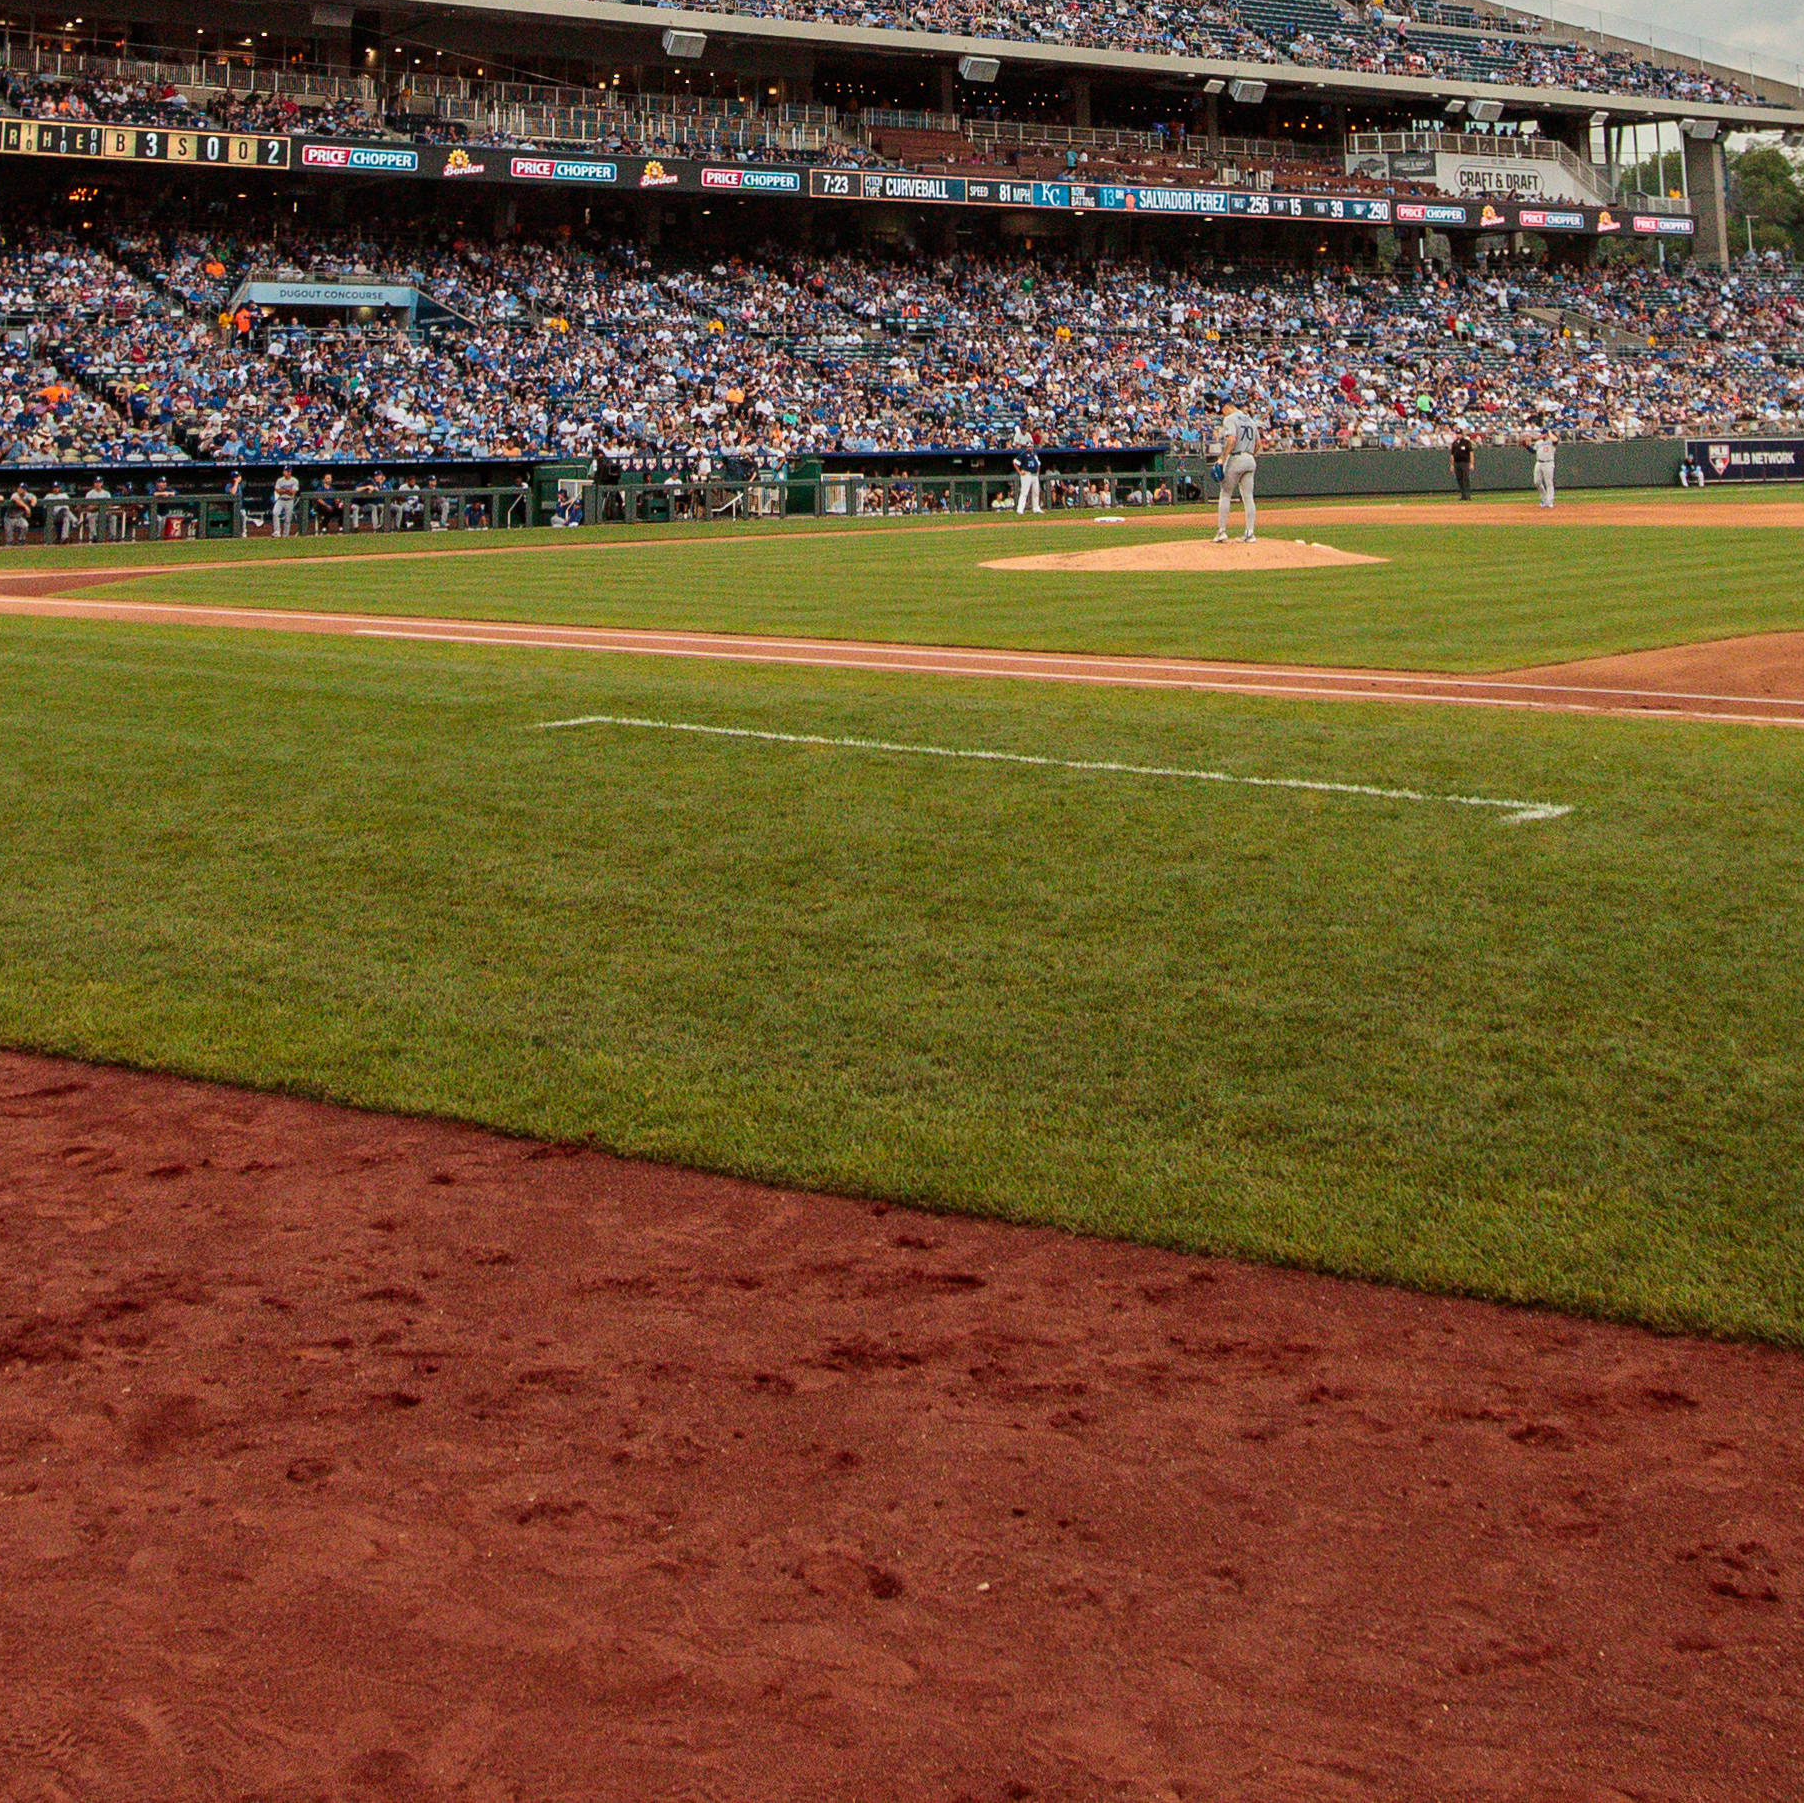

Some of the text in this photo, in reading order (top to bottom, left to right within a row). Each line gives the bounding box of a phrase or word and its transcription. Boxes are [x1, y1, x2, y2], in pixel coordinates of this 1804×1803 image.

[9, 129, 84, 149] R H E
[116, 134, 126, 152] B
[146, 133, 158, 157] 3
[178, 138, 188, 156] S
[207, 136, 219, 160] 0
[268, 141, 280, 165] 2
[308, 149, 412, 167] PRICE CHOPPER
[444, 164, 484, 175] Borden
[516, 162, 612, 179] PRICE CHOPPER
[642, 174, 677, 186] Borden
[706, 173, 795, 188] PRICE CHOPPER
[823, 175, 848, 194] 7:23
[865, 175, 883, 187] PITCH
[886, 177, 948, 198] CURVEBALL
[1460, 171, 1538, 190] CRAFT & DRAFT
[865, 186, 881, 197] TYPE
[970, 184, 1031, 202] SPEED 81 MPH
[1041, 183, 1060, 206] KC
[1102, 189, 1115, 206] 13
[1139, 190, 1193, 211] SALVADOR
[1194, 192, 1225, 212] PEREZ
[1247, 196, 1269, 214] .256
[1289, 199, 1302, 216] 15
[1330, 201, 1343, 218] 39
[1368, 203, 1388, 220] .290
[1400, 208, 1462, 220] PRICE CHOPPER
[1523, 214, 1581, 226] PRICE CHOPPER
[1636, 219, 1690, 231] PRICE CHOPPER
[280, 289, 383, 300] DUGOUT CONCOURSE
[1240, 425, 1254, 441] 70
[1731, 452, 1795, 465] MLB NETWORK
